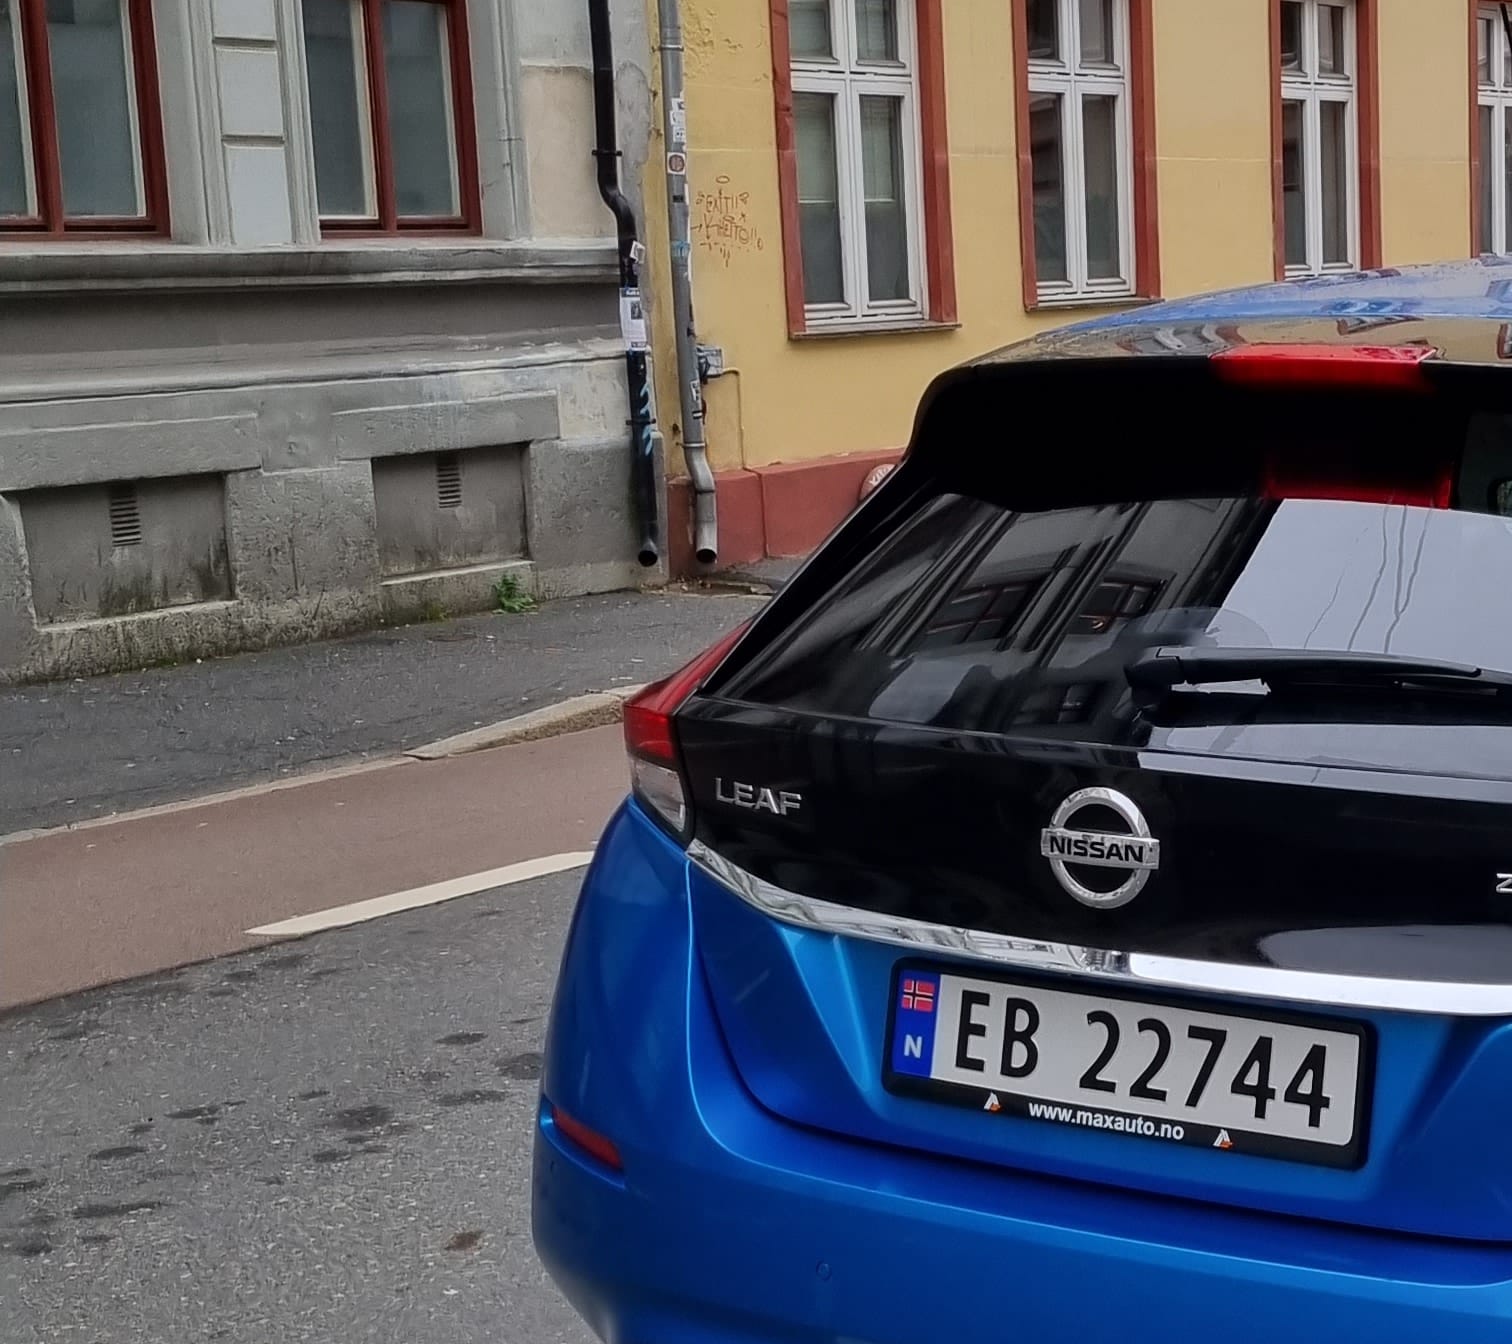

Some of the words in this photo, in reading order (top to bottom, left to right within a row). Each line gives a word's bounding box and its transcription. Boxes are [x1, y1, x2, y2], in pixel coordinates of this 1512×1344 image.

[715, 777, 802, 816] LEAF
[1050, 836, 1144, 863] NISSAN
[904, 1034, 922, 1058] N
[955, 989, 1040, 1078] EB
[1079, 1010, 1331, 1128] 22744
[1028, 1102, 1185, 1141] www.maxauto.no
